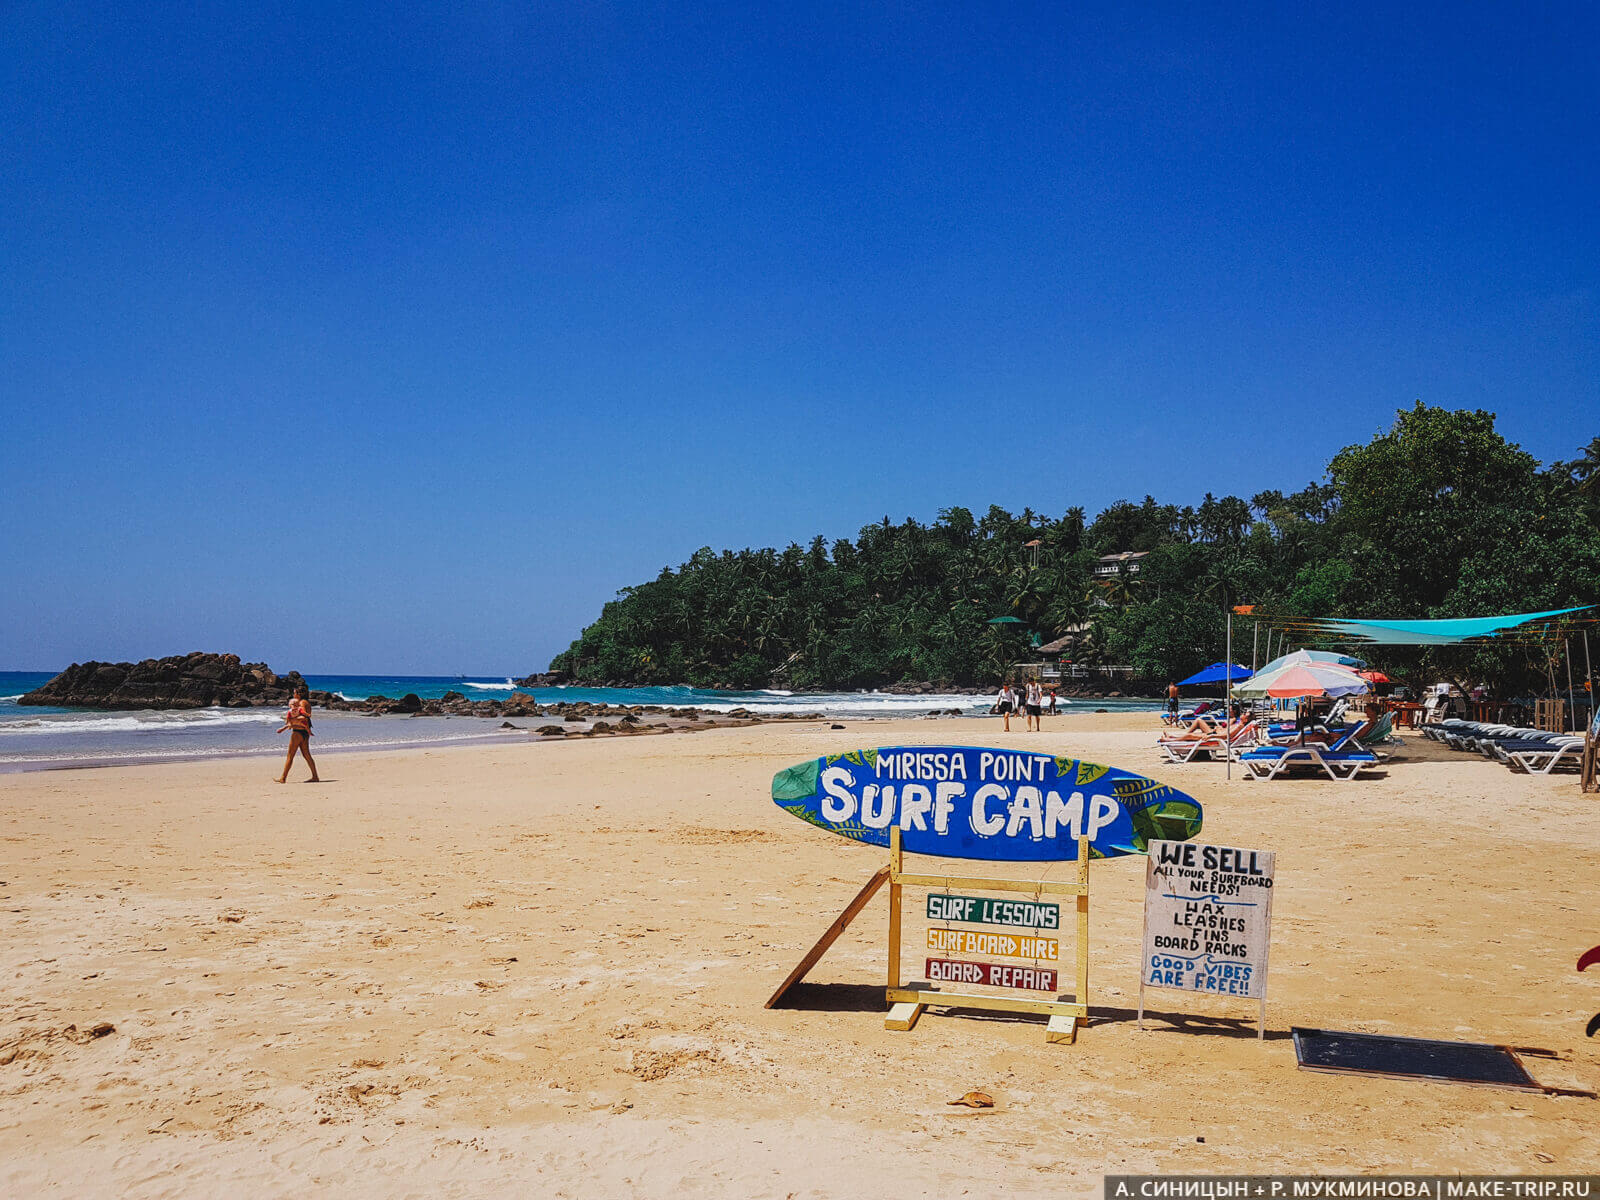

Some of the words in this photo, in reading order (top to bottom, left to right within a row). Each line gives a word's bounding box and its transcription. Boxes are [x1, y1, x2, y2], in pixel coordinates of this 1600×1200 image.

[876, 753, 967, 780] MIRISSA
[980, 753, 1051, 781] POINT
[821, 766, 966, 835] SURF
[969, 785, 1119, 842] CAMP
[1160, 844, 1197, 867] WE
[1203, 846, 1262, 875] SELL
[1154, 866, 1174, 876] ALL
[1178, 868, 1204, 879] YOUR
[1211, 871, 1273, 888] SURFBOARD
[1190, 881, 1240, 896] NEEDS!
[928, 897, 973, 921] SURF
[982, 900, 1058, 928] LESSONS
[1186, 902, 1224, 915] WAX
[1174, 913, 1245, 932] LEASHES
[1193, 928, 1229, 942] FINS
[927, 929, 1017, 956] SURFBOARD
[1020, 936, 1058, 959] HIRE
[1155, 936, 1199, 951] BOARD
[1205, 942, 1247, 957] RACKS
[930, 961, 983, 983] BOARD
[989, 965, 1052, 990] REPAIR
[1151, 955, 1194, 971] GOOD
[1204, 963, 1252, 980] VIBES
[1150, 970, 1184, 986] ARE
[1195, 973, 1249, 995] FREE!!
